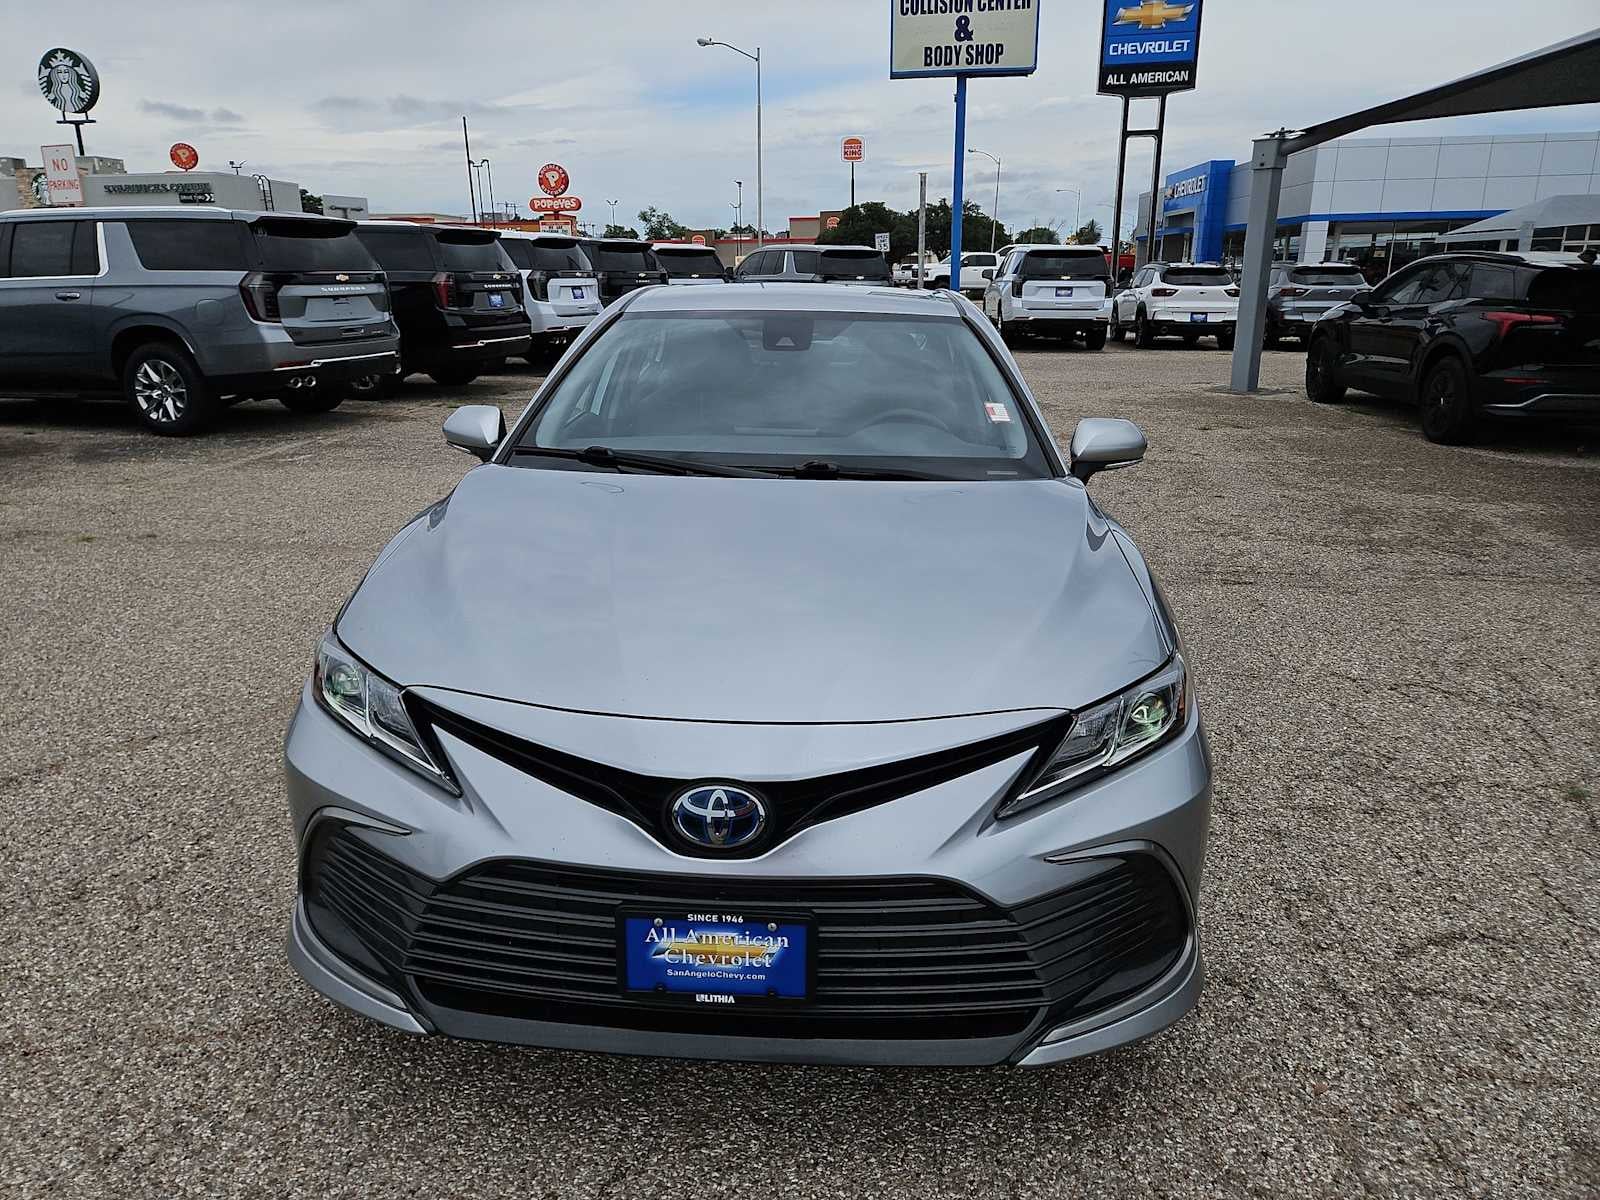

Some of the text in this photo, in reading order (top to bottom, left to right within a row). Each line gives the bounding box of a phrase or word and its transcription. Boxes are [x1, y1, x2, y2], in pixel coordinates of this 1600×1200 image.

[900, 0, 973, 16] COLLISION
[954, 15, 974, 42] &
[924, 43, 1004, 67] BODY SHOP
[1109, 40, 1190, 56] CHEVROLET
[1106, 70, 1189, 85] ALL AMERICAN
[51, 158, 68, 171] NO
[48, 178, 79, 191] PARKING
[1174, 175, 1207, 198] CHEVROLET
[687, 913, 744, 924] SINCE 1946
[644, 927, 790, 948] All American
[664, 949, 773, 968] Chevrolet
[667, 969, 766, 981] SanAngeloChevy.com
